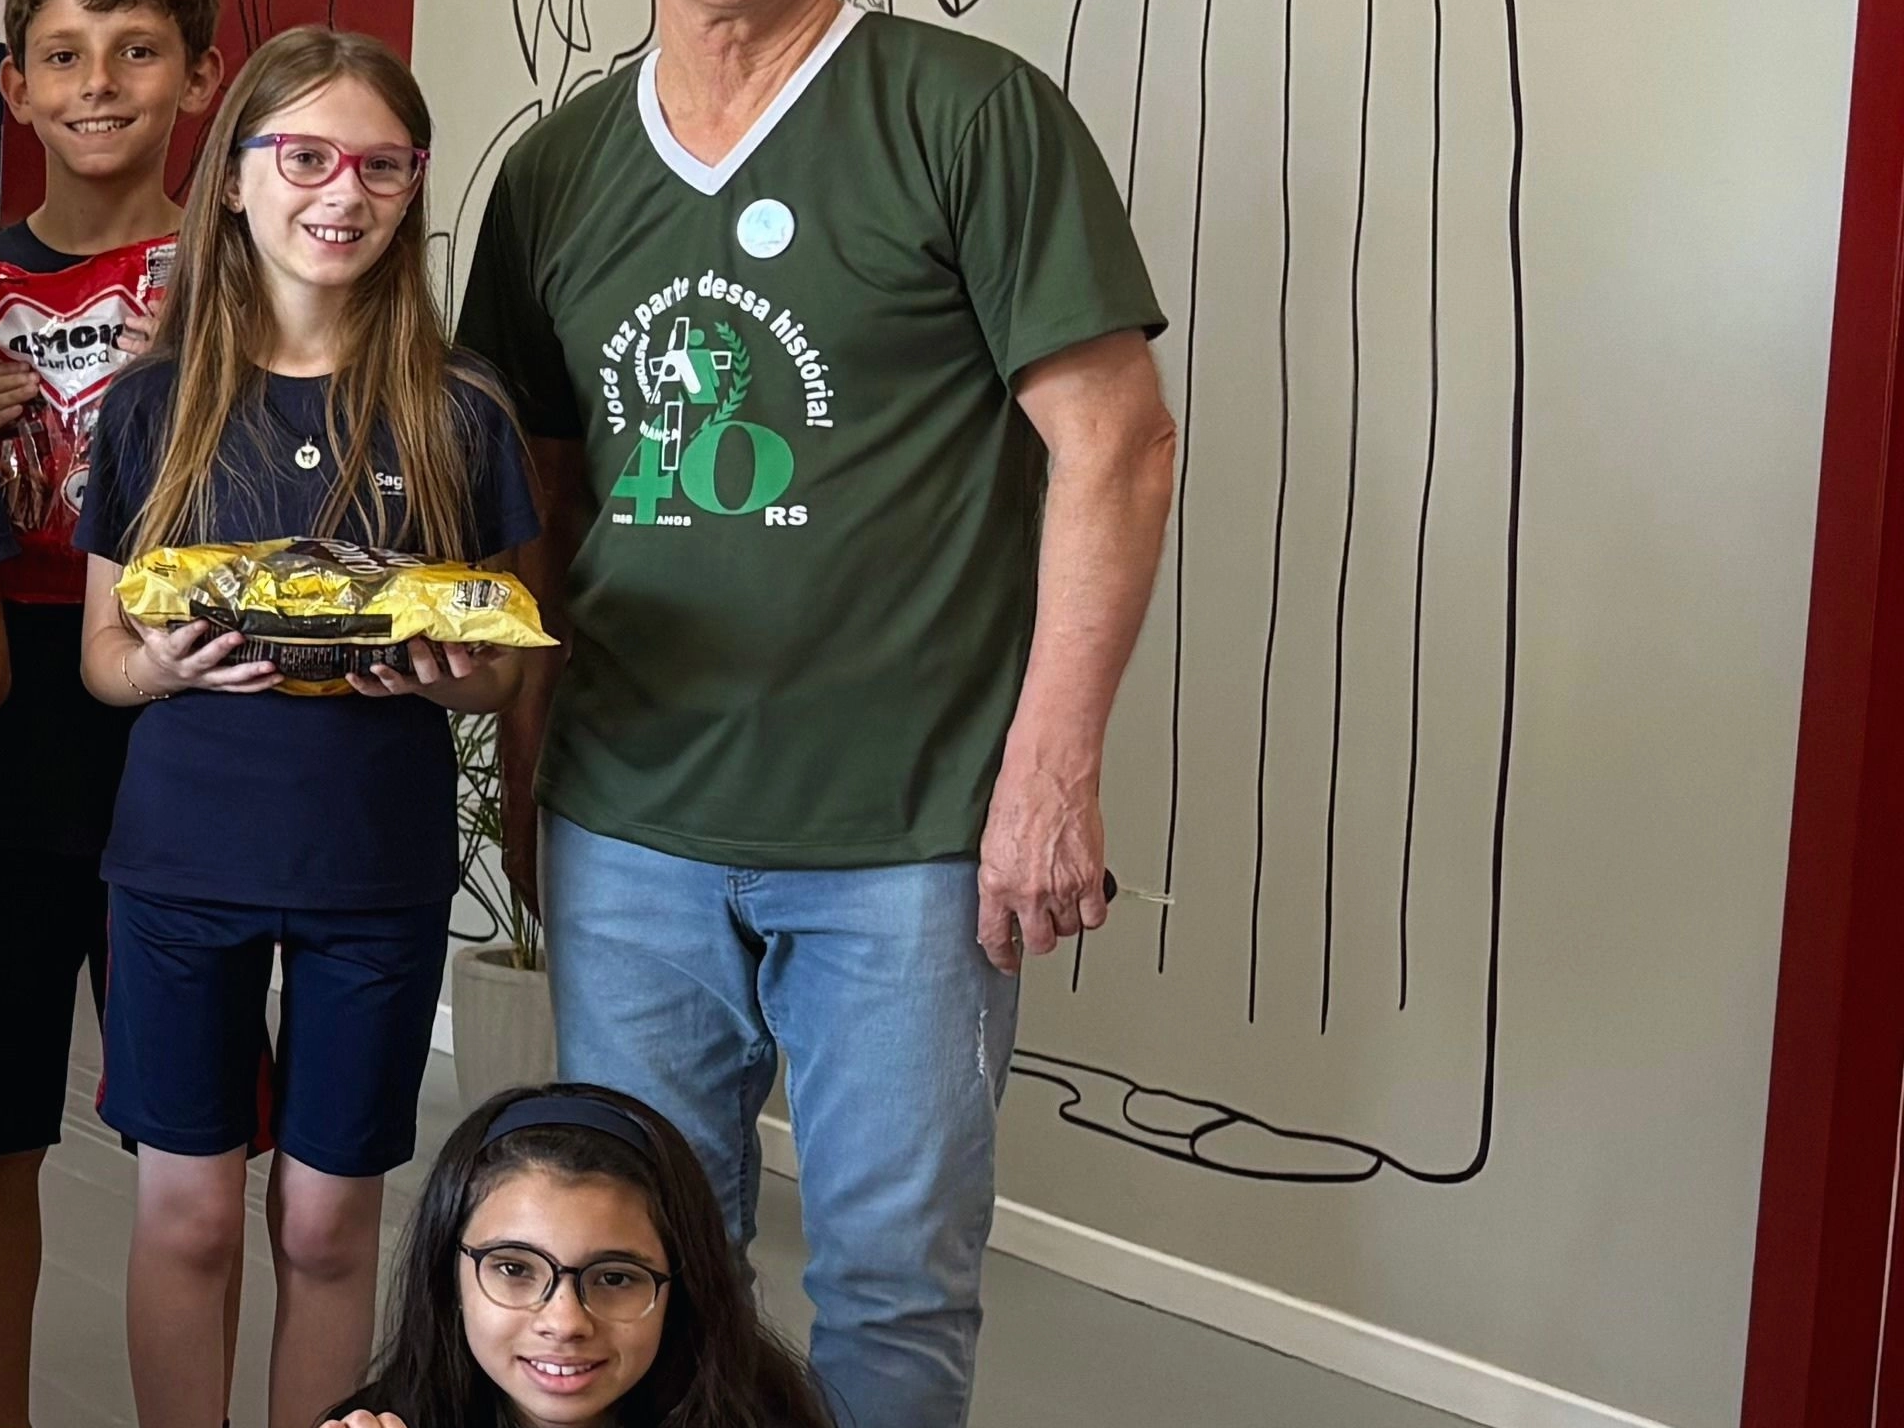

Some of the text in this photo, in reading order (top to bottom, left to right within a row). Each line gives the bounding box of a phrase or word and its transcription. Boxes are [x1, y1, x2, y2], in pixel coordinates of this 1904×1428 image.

[602, 320, 637, 362] faz
[634, 277, 690, 330] parte
[698, 270, 770, 321] dessa
[610, 416, 794, 525] 40
[764, 505, 809, 526] RS
